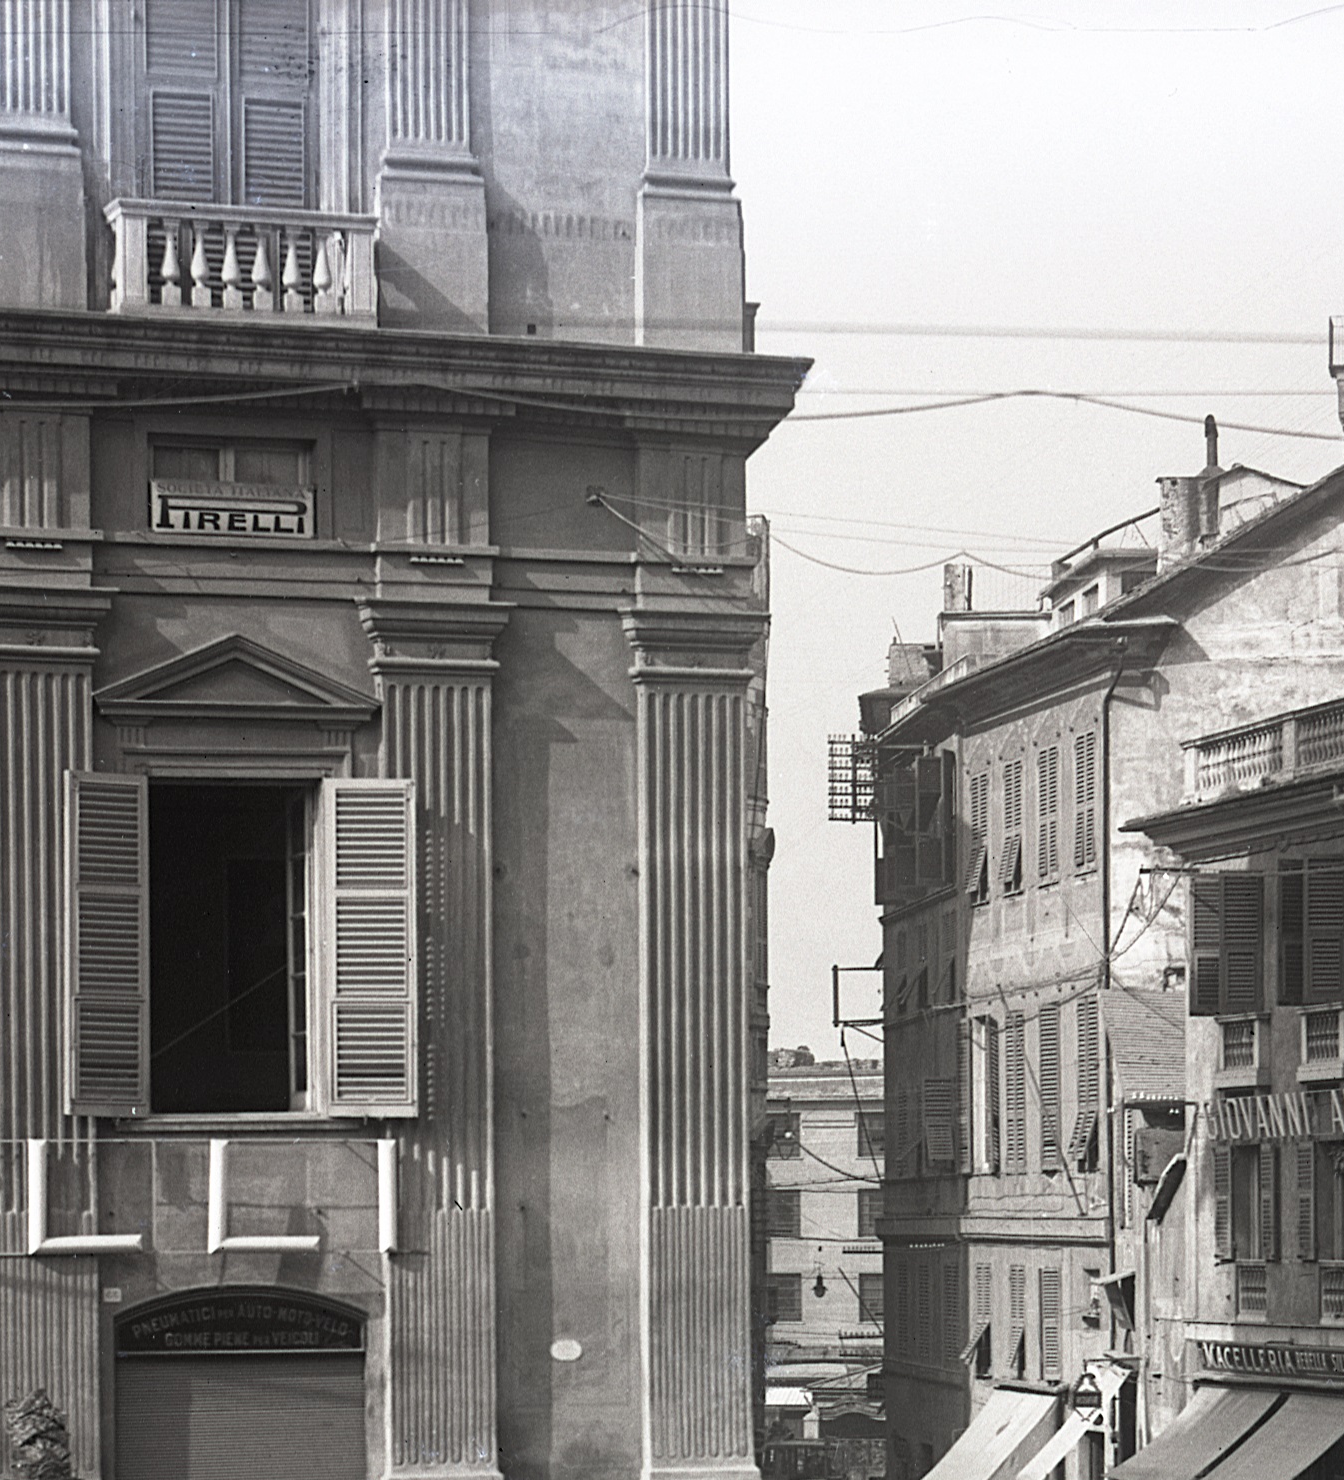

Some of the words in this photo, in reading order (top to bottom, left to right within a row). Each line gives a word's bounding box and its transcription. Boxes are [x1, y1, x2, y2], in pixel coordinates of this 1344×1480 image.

[156, 494, 307, 534] PIRELLI
[1205, 1092, 1311, 1140] GIOVANNI
[131, 1306, 216, 1338] PNEUMATICI
[165, 1332, 211, 1347] GOMME
[213, 1332, 249, 1347] PIENE
[271, 1331, 319, 1345] VEICOLI
[1202, 1342, 1296, 1375] MACELLERIA
